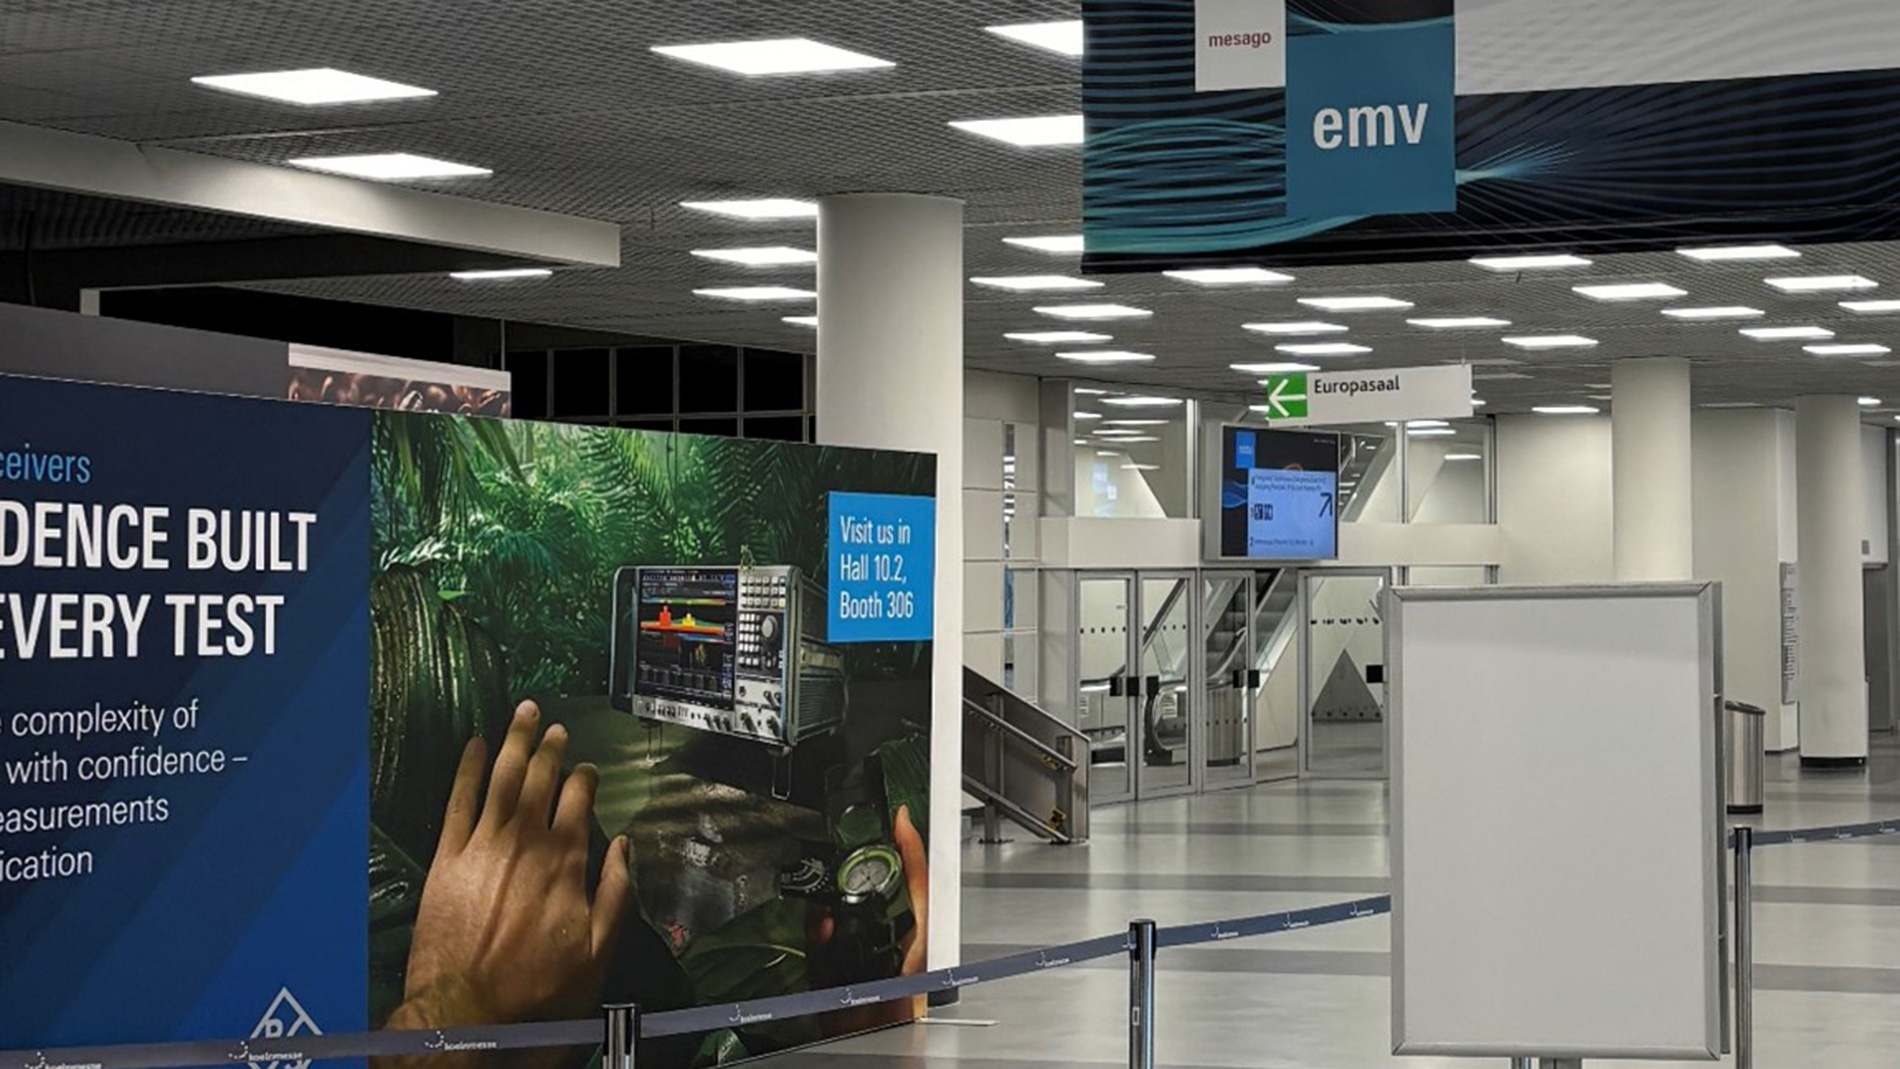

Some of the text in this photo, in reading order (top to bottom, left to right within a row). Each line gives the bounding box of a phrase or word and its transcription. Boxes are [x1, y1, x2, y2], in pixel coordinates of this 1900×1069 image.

[1208, 30, 1272, 49] mesago
[1312, 102, 1429, 151] emv
[1314, 375, 1400, 395] Europasaal
[0, 500, 317, 572] DENCE BUILT
[840, 515, 911, 545] Visit us in
[840, 553, 907, 584] Hall 10.2,
[840, 591, 914, 619] Booth 306
[0, 593, 285, 660] VERY TEST
[11, 701, 164, 740] complexity
[173, 698, 200, 730] of
[6, 751, 68, 784] with
[77, 747, 226, 782] confidence
[0, 795, 170, 834] asurements
